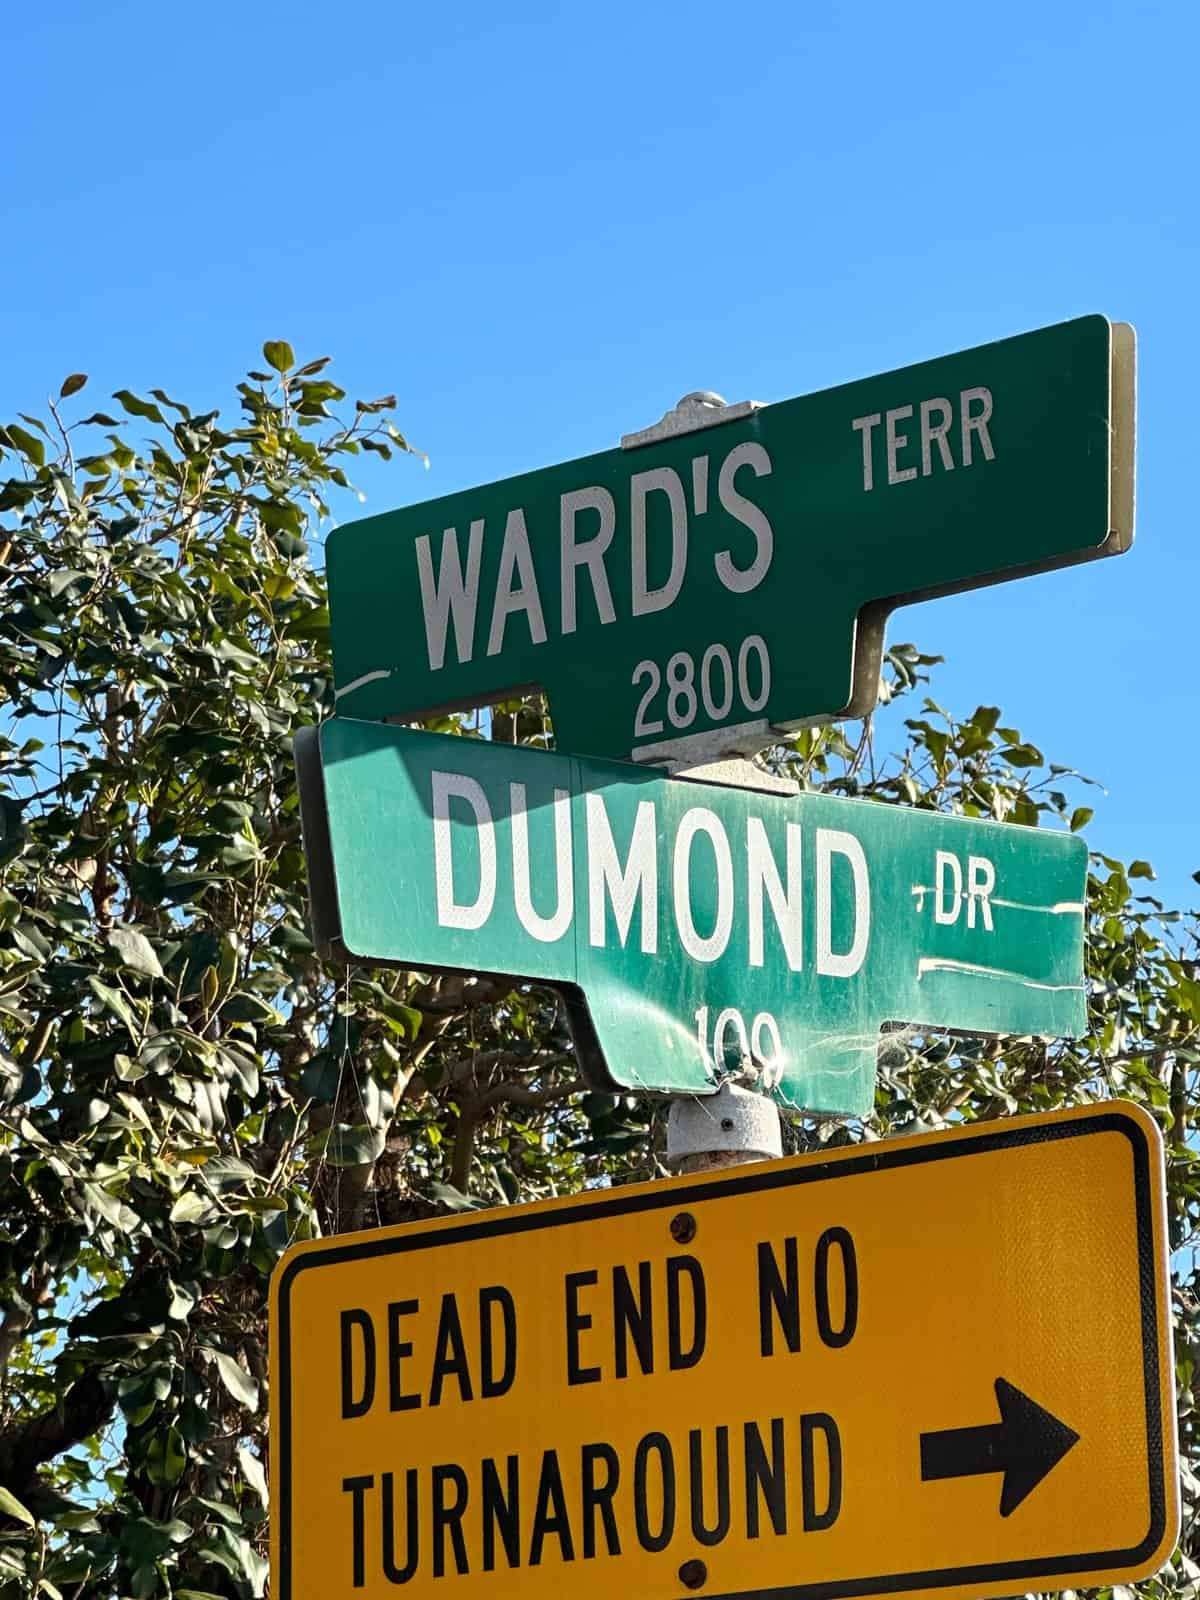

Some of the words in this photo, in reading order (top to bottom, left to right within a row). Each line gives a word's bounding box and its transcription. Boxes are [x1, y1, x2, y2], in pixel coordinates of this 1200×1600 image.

[414, 442, 774, 671] WARD'S
[852, 387, 996, 491] TERR
[632, 634, 772, 738] 2800
[431, 770, 871, 978] DUMOND
[935, 850, 995, 932] DR
[694, 1005, 784, 1089] 100
[340, 1285, 517, 1419] DEAD
[565, 1254, 707, 1386] END
[757, 1226, 859, 1358] NO
[342, 1412, 842, 1588] TURNAROUND
